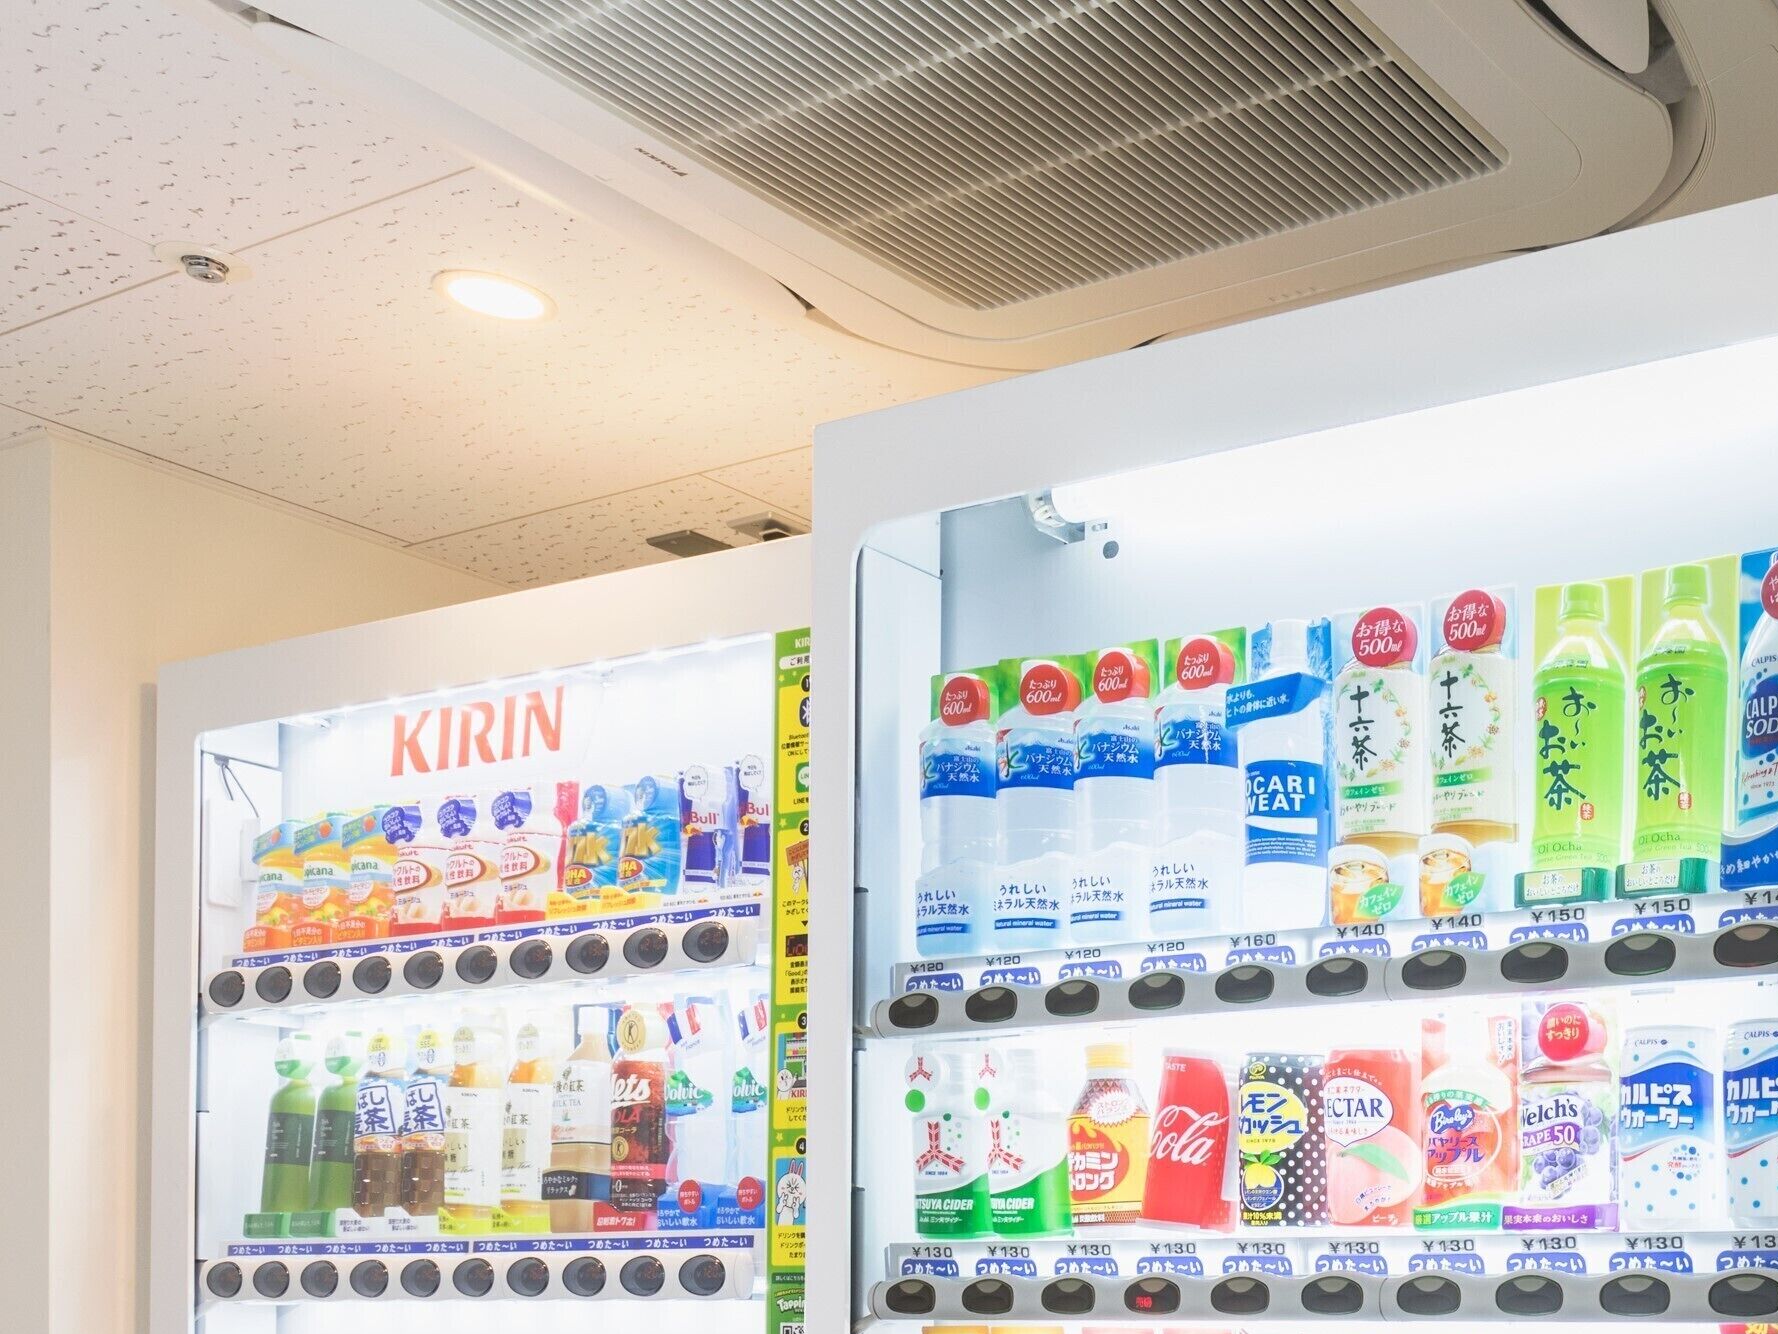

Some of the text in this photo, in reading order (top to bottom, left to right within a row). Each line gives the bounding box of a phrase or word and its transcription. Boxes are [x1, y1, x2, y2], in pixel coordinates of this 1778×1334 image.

[1448, 603, 1489, 622] お得な
[1356, 619, 1405, 638] お得な
[1098, 677, 1128, 691] 600ml
[945, 690, 969, 702] たっぷり
[1026, 690, 1062, 703] 600ml
[943, 701, 972, 715] 600ml
[1439, 670, 1466, 758] 十六茶
[390, 686, 564, 778] KIRIN
[1349, 685, 1377, 771] 十六茶
[937, 761, 981, 774] バナジウム
[1539, 720, 1587, 810] お茶
[948, 773, 980, 783] 天然水
[690, 812, 717, 825] Bull
[1000, 884, 1046, 897] うれしい
[1360, 887, 1397, 909] カフェイン
[1373, 901, 1393, 915] ゼロ
[1635, 898, 1691, 915] ¥150
[1431, 914, 1482, 930] ¥140
[1531, 908, 1585, 923] ¥150
[1336, 923, 1385, 939] ¥140
[1230, 933, 1276, 948] ¥160
[986, 955, 1021, 967] ¥120
[1065, 948, 1101, 960] ¥120
[910, 962, 944, 972] ¥120
[1546, 1027, 1580, 1040] すっきり
[1621, 1083, 1693, 1106] カルピス
[1621, 1106, 1694, 1129] ウォーター
[1151, 1104, 1229, 1166] Cola
[943, 1198, 973, 1210] CIDER
[1504, 1213, 1589, 1225] 果実本来のおいしさ
[1067, 1244, 1111, 1256] ¥130
[1151, 1242, 1196, 1255] ¥130
[1237, 1242, 1285, 1255] ¥130
[1330, 1241, 1379, 1254] ¥130
[1423, 1240, 1475, 1252] ¥130
[1522, 1236, 1576, 1251] ¥130
[1627, 1236, 1683, 1250] ¥130
[912, 1246, 952, 1258] ¥130
[987, 1246, 1030, 1258] ¥130
